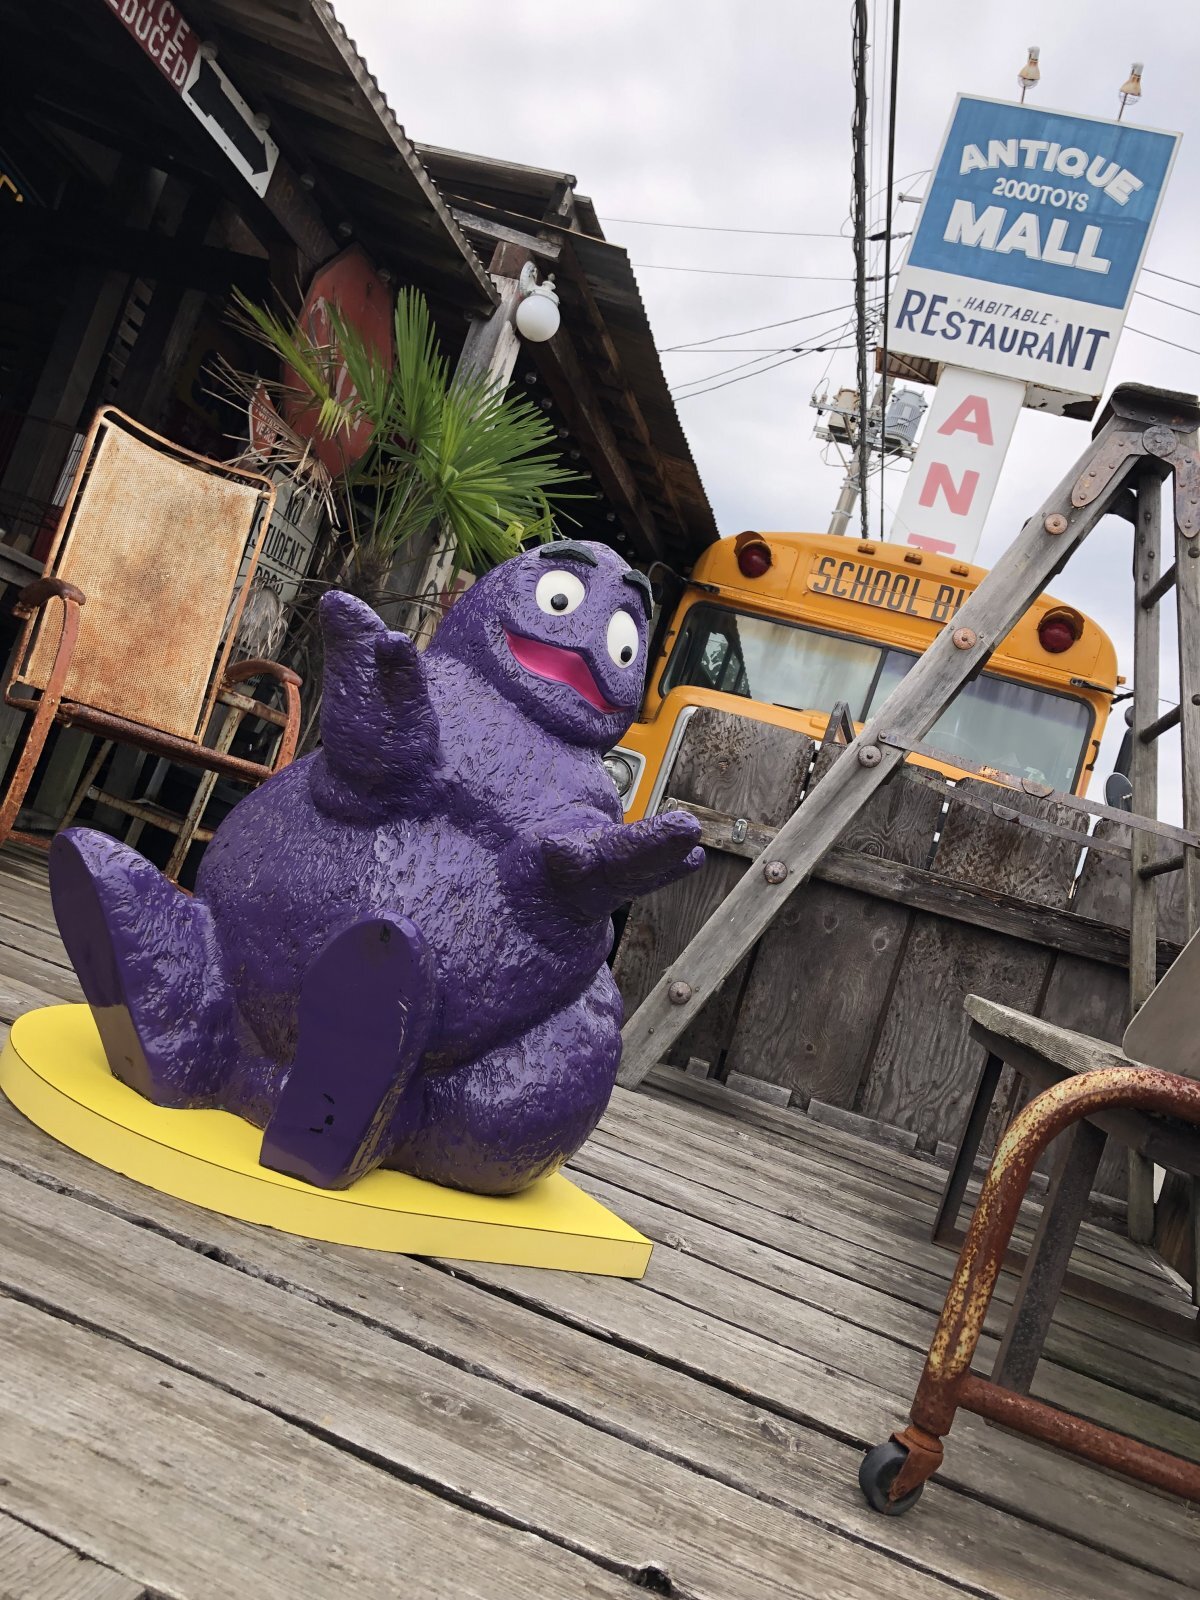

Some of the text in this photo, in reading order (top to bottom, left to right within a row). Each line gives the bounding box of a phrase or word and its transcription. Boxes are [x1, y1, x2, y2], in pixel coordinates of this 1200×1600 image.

[108, 0, 189, 87] DUCED
[958, 138, 1145, 206] ANTIQUE
[991, 177, 1090, 213] 2000TOYS
[942, 198, 1112, 275] MALL
[894, 287, 1111, 372] RESTAURANT
[963, 296, 1054, 326] HABITABLE
[252, 516, 306, 575] STUDENT
[812, 556, 921, 616] SCHOOL
